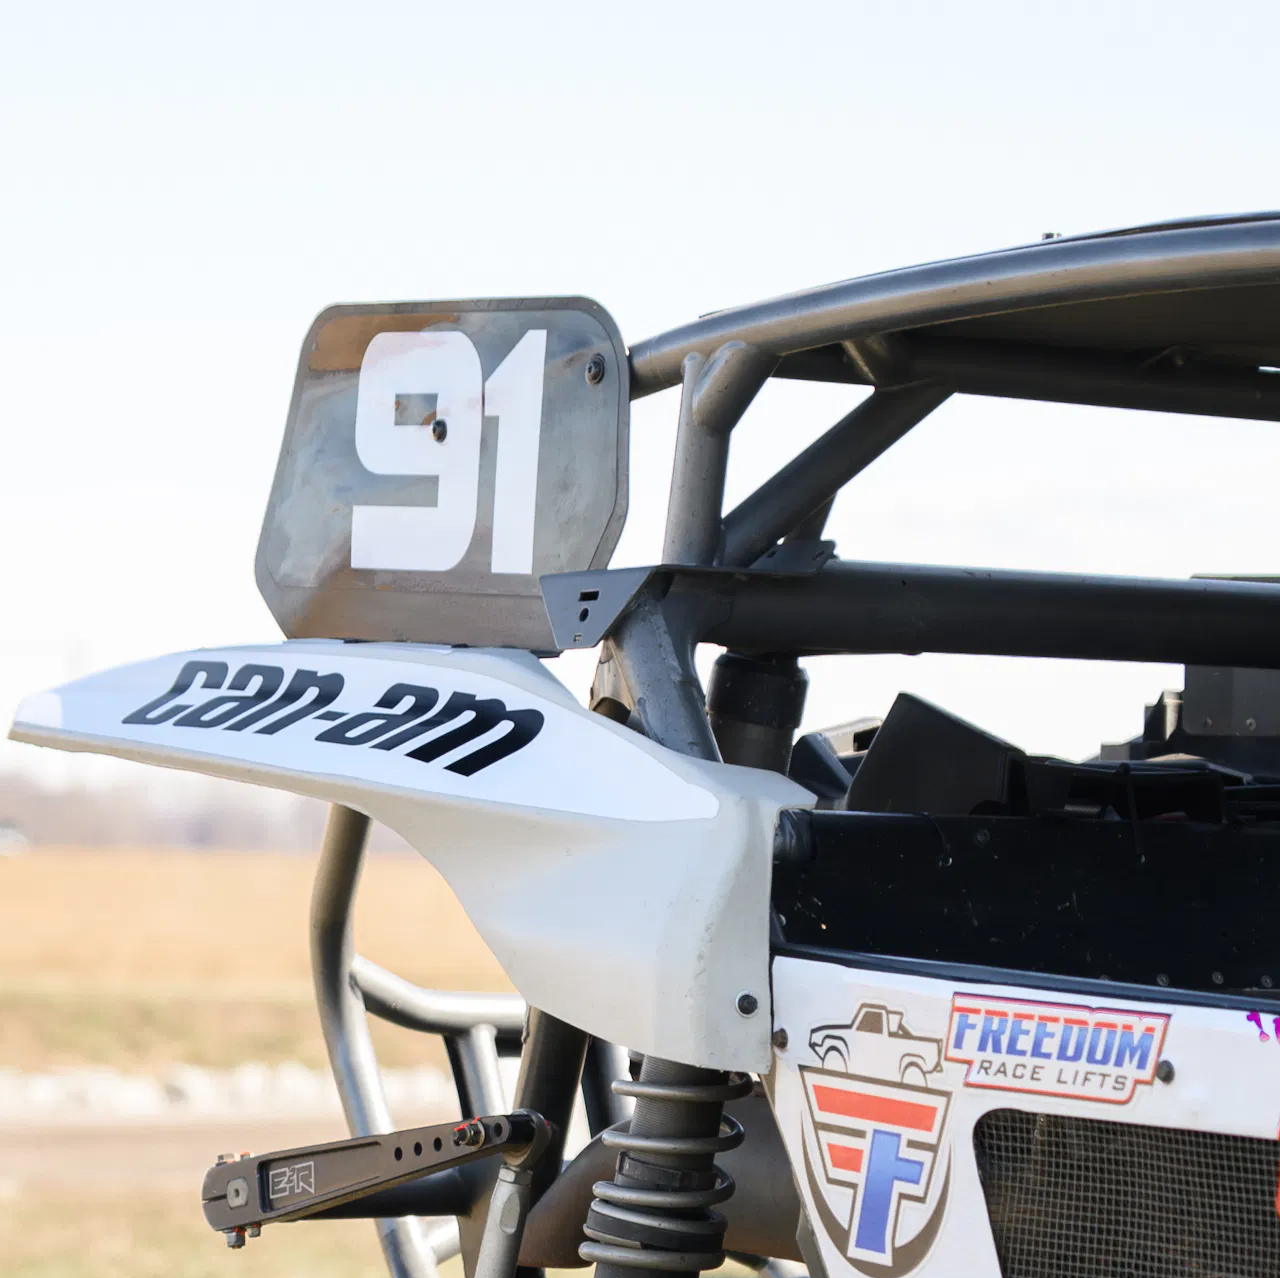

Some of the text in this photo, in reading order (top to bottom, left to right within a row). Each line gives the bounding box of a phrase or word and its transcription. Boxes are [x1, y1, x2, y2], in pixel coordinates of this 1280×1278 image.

[349, 328, 548, 575] 91
[122, 660, 546, 777] can-am
[953, 1005, 1156, 1071] FREEDOM
[976, 1059, 1129, 1091] RACE LIFTS
